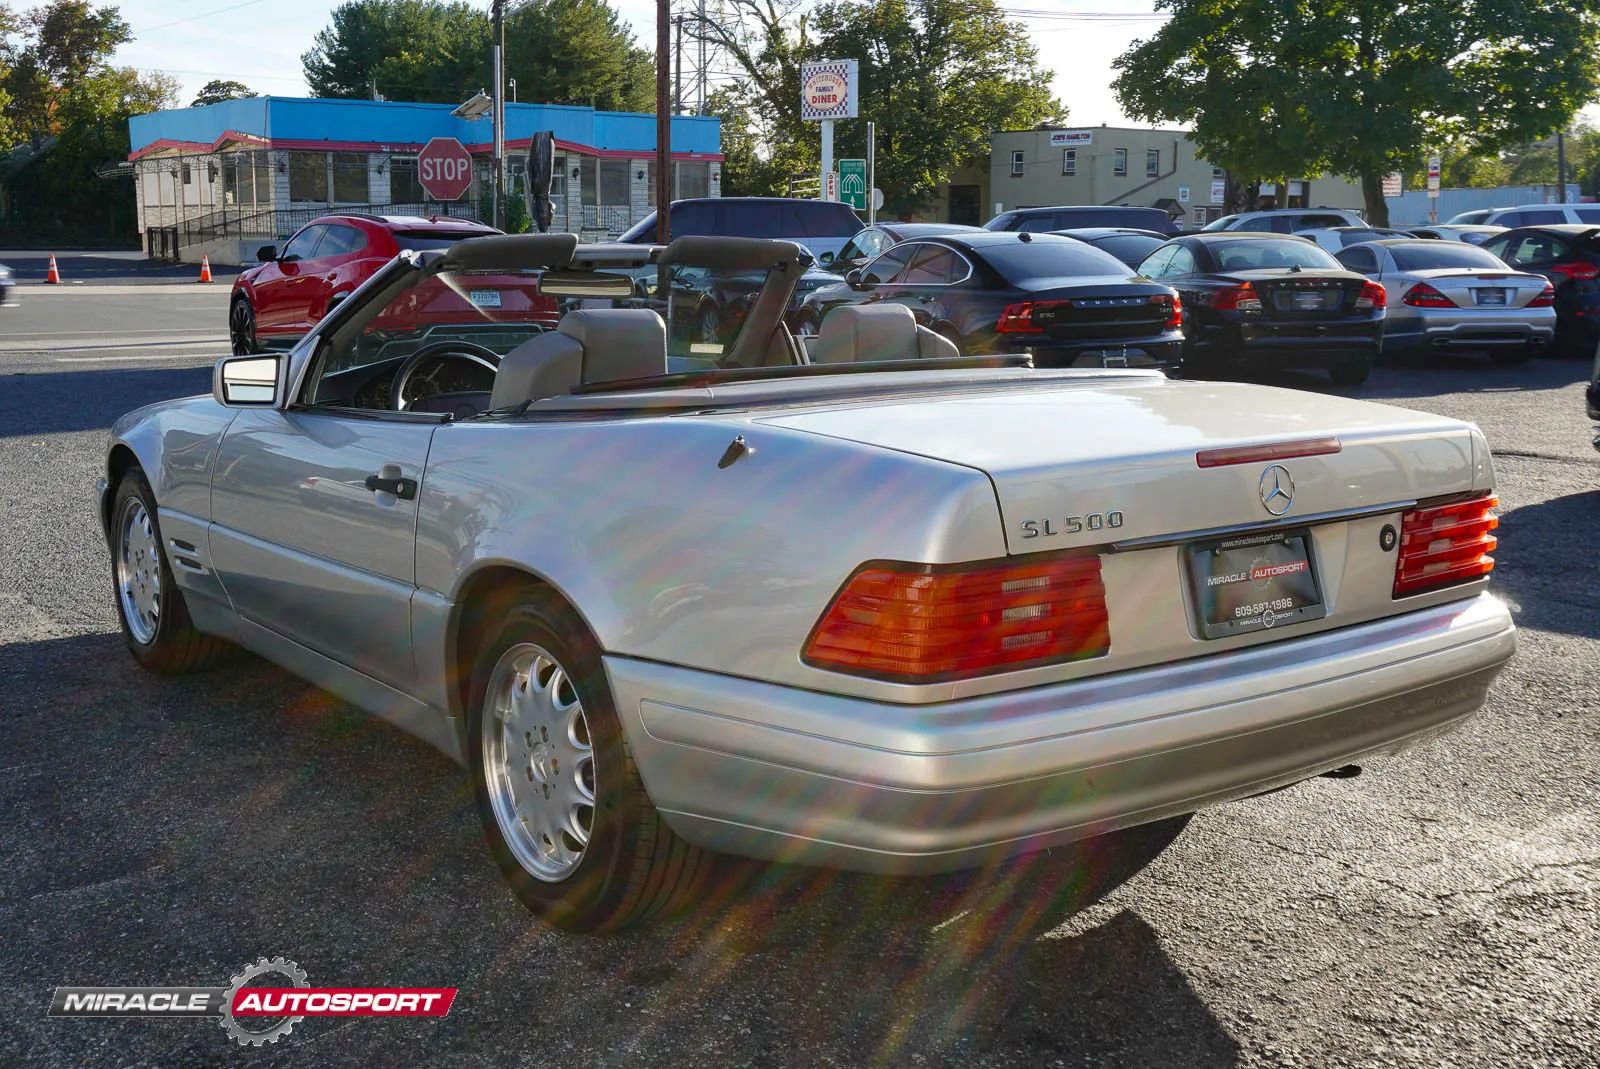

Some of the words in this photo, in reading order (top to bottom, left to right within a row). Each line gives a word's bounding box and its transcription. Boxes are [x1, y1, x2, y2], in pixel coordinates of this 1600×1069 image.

[811, 95, 838, 104] DINER
[422, 158, 468, 180] STOP
[1021, 518, 1058, 539] SL
[1064, 510, 1123, 534] 500
[1207, 572, 1247, 587] MIRACLE
[1253, 562, 1305, 579] AUTOSPORT
[1239, 617, 1262, 627] MIRACLE
[1265, 611, 1294, 622] AUTOSPORT
